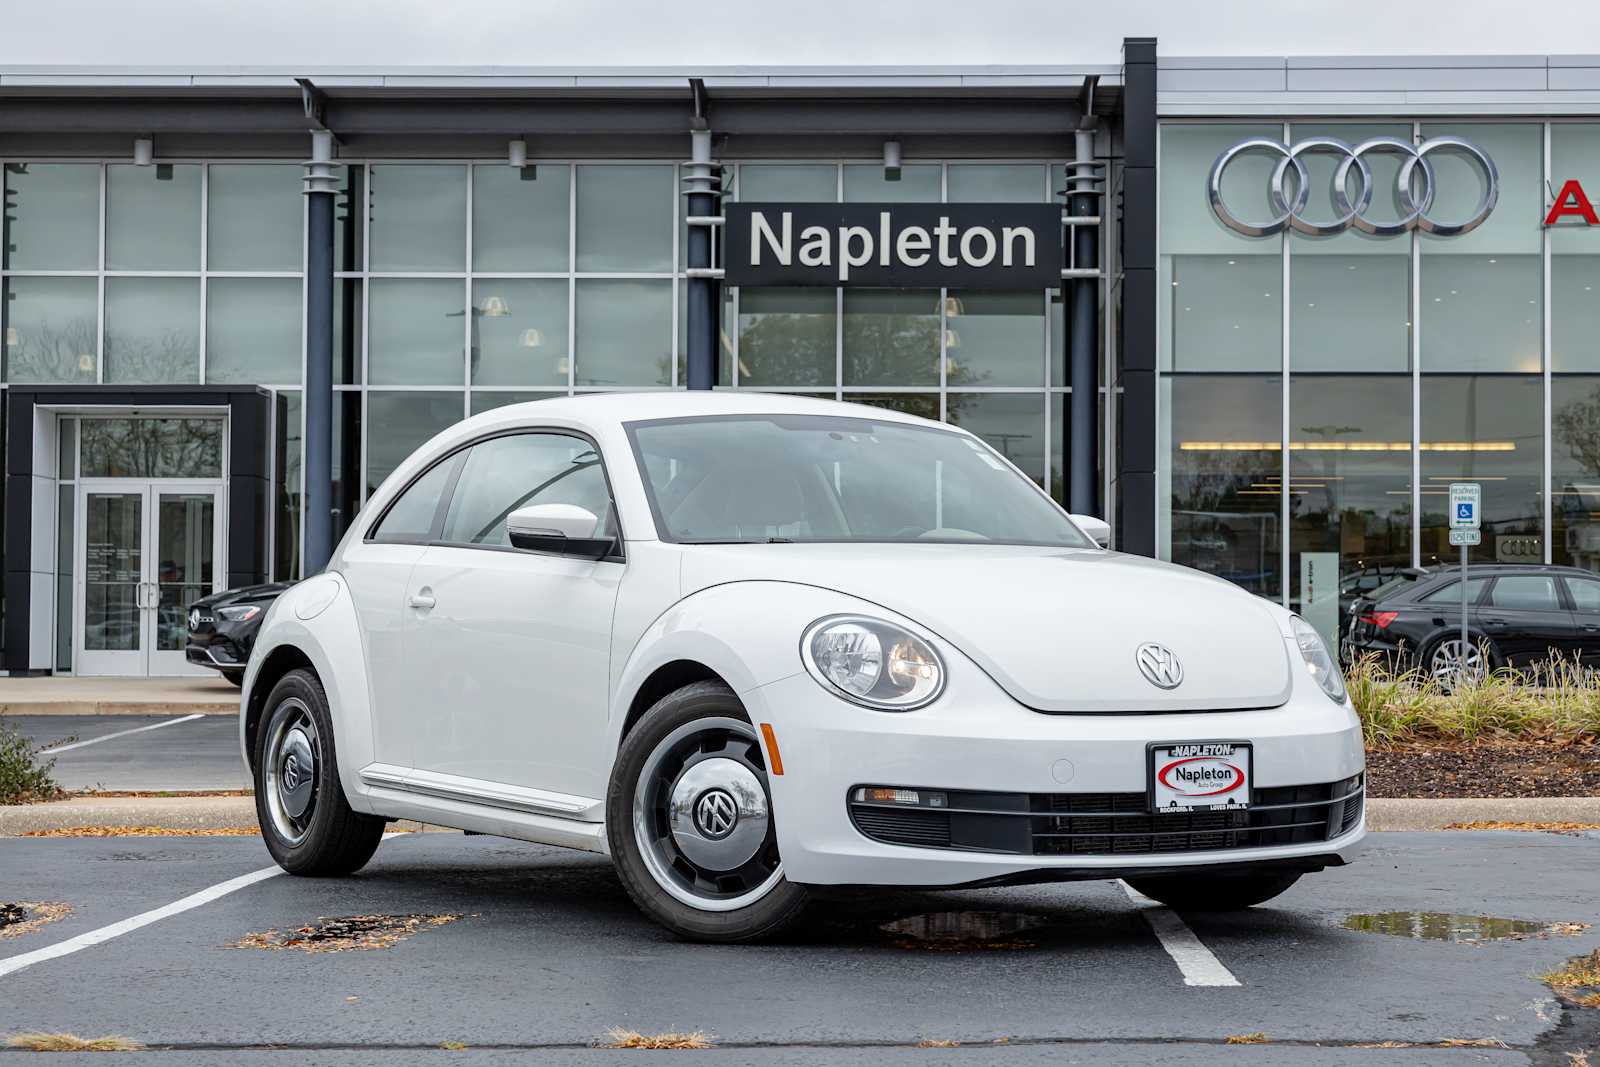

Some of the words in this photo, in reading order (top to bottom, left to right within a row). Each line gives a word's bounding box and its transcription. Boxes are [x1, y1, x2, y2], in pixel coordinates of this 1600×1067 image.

[750, 211, 1035, 281] Napleton
[1174, 744, 1231, 757] NAPLETON
[1175, 767, 1232, 783] Napleton
